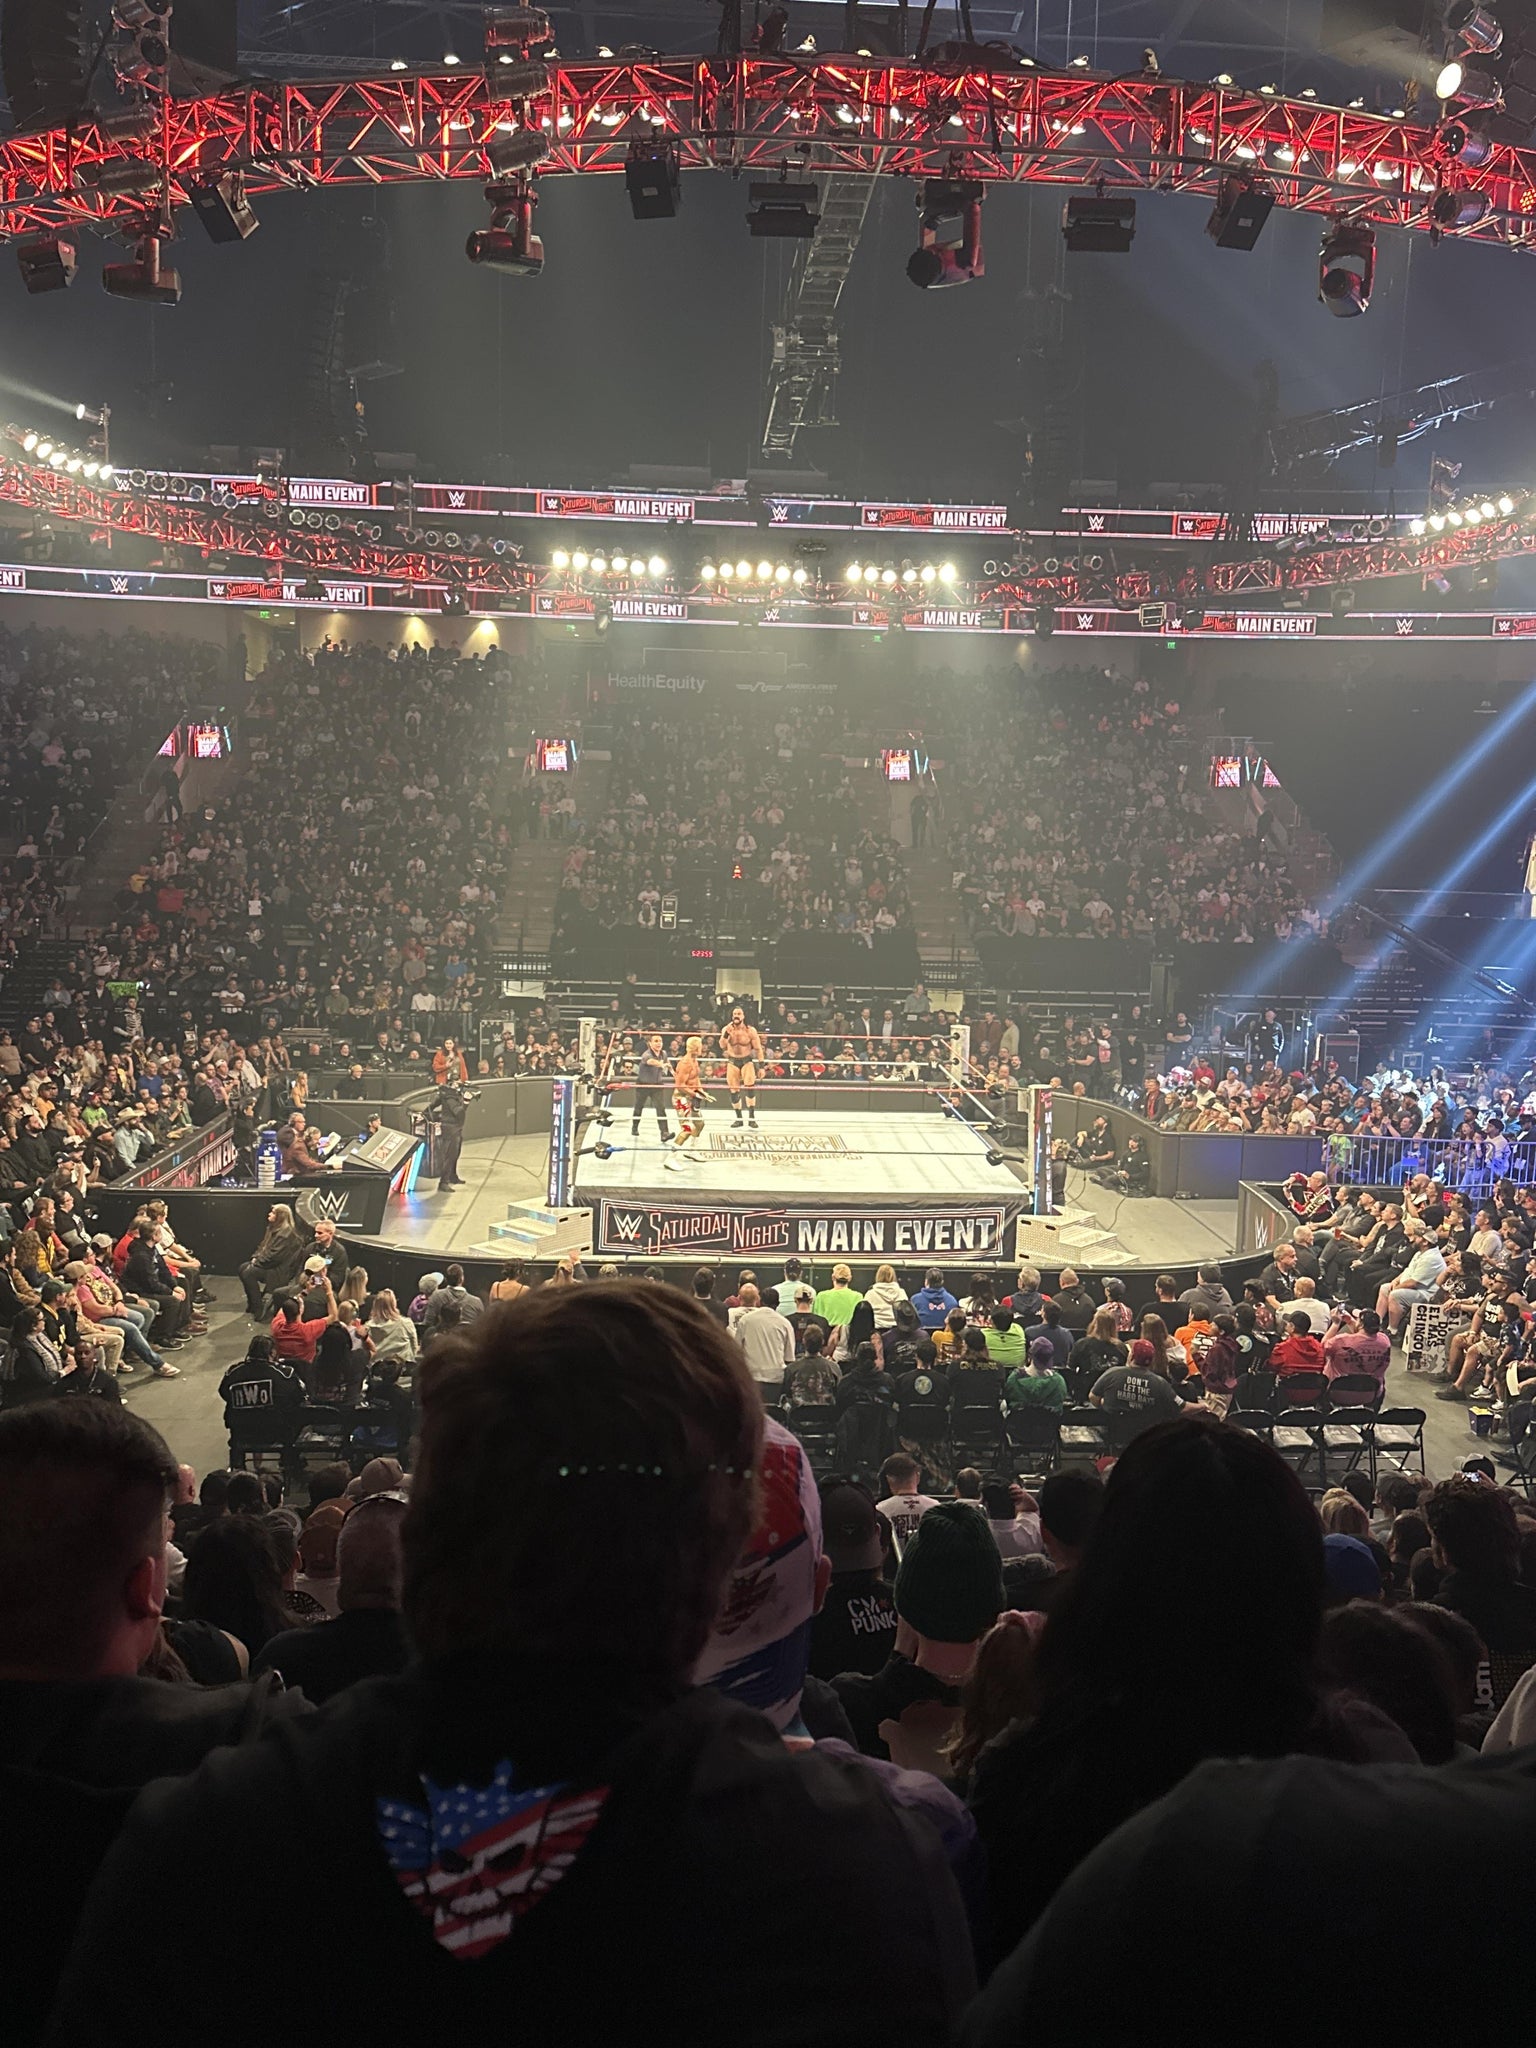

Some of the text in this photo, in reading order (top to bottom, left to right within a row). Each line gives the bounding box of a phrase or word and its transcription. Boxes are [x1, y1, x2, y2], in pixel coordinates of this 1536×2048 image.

[324, 486, 364, 502] EVENT
[560, 496, 592, 514] SATURDAY
[614, 500, 650, 515] MAIN
[651, 501, 690, 516] EVENT
[880, 509, 912, 527] SATURDAY
[934, 511, 968, 526] MAIN
[226, 582, 258, 600] SATURDAY
[644, 602, 684, 616] EVENT
[924, 610, 958, 625] MAIN
[1236, 618, 1270, 632] MAIN
[1272, 618, 1313, 632] EVENT
[608, 672, 705, 692] HealthEquity
[552, 1103, 561, 1147] MAIN
[550, 1153, 558, 1206] EVENT
[648, 1212, 730, 1254] SATURDAY
[734, 1216, 790, 1249] NIGHT'S
[798, 1220, 884, 1252] MAIN
[894, 1218, 995, 1251] EVENT
[1427, 1306, 1440, 1347] EL MAS
[1437, 1321, 1448, 1346] DOM
[1124, 1384, 1150, 1396] LET THE
[1126, 1376, 1149, 1387] DON'T
[852, 1610, 898, 1635] PUNK
